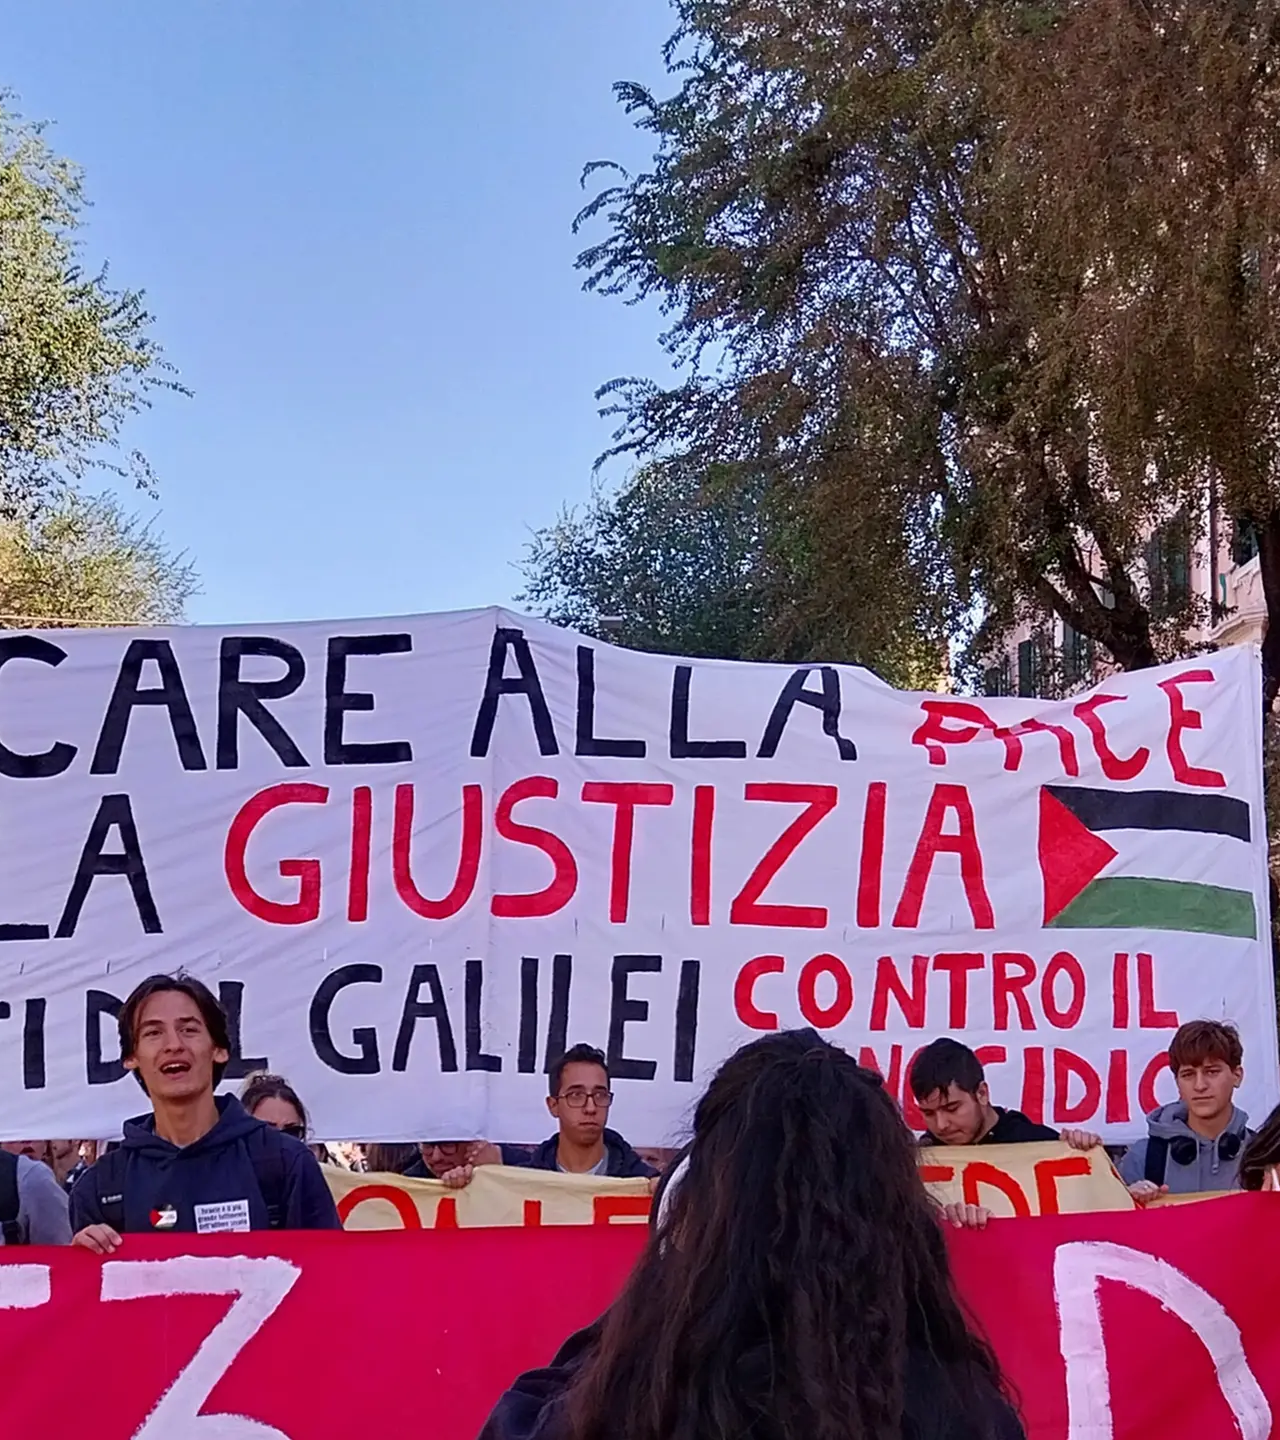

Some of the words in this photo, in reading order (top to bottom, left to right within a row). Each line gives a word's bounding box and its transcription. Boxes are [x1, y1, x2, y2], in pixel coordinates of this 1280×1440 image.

[470, 627, 857, 761] ALLA
[912, 669, 1226, 787] PACE
[225, 775, 995, 931] GIUSTIZIA
[86, 981, 268, 1087] DL
[310, 954, 701, 1083] GALILEI
[734, 953, 1085, 1031] CONTRO
[1113, 952, 1179, 1029] IL
